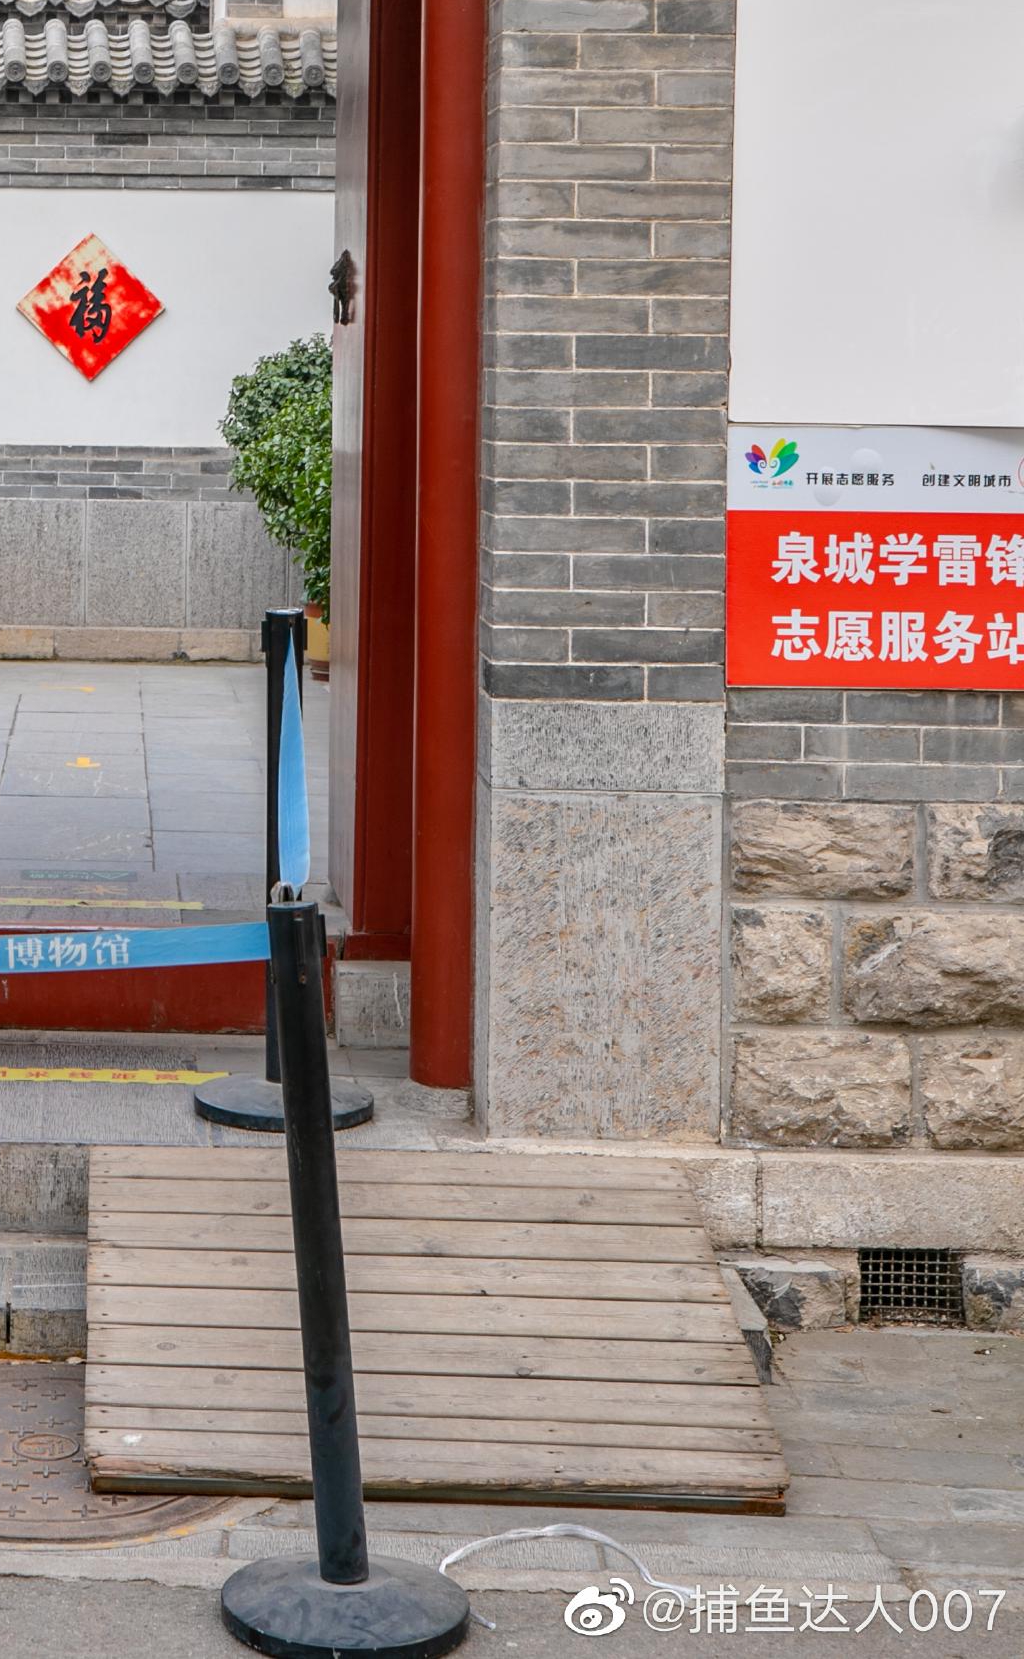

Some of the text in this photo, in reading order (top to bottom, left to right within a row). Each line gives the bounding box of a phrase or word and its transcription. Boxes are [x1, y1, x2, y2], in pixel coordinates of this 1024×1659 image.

[69, 268, 112, 344] 福
[806, 472, 895, 486] 开展志愿服务
[922, 473, 1012, 487] 创建文明城市
[771, 531, 1024, 587] 泉城学雷锋
[771, 609, 1024, 664] 志愿服务站
